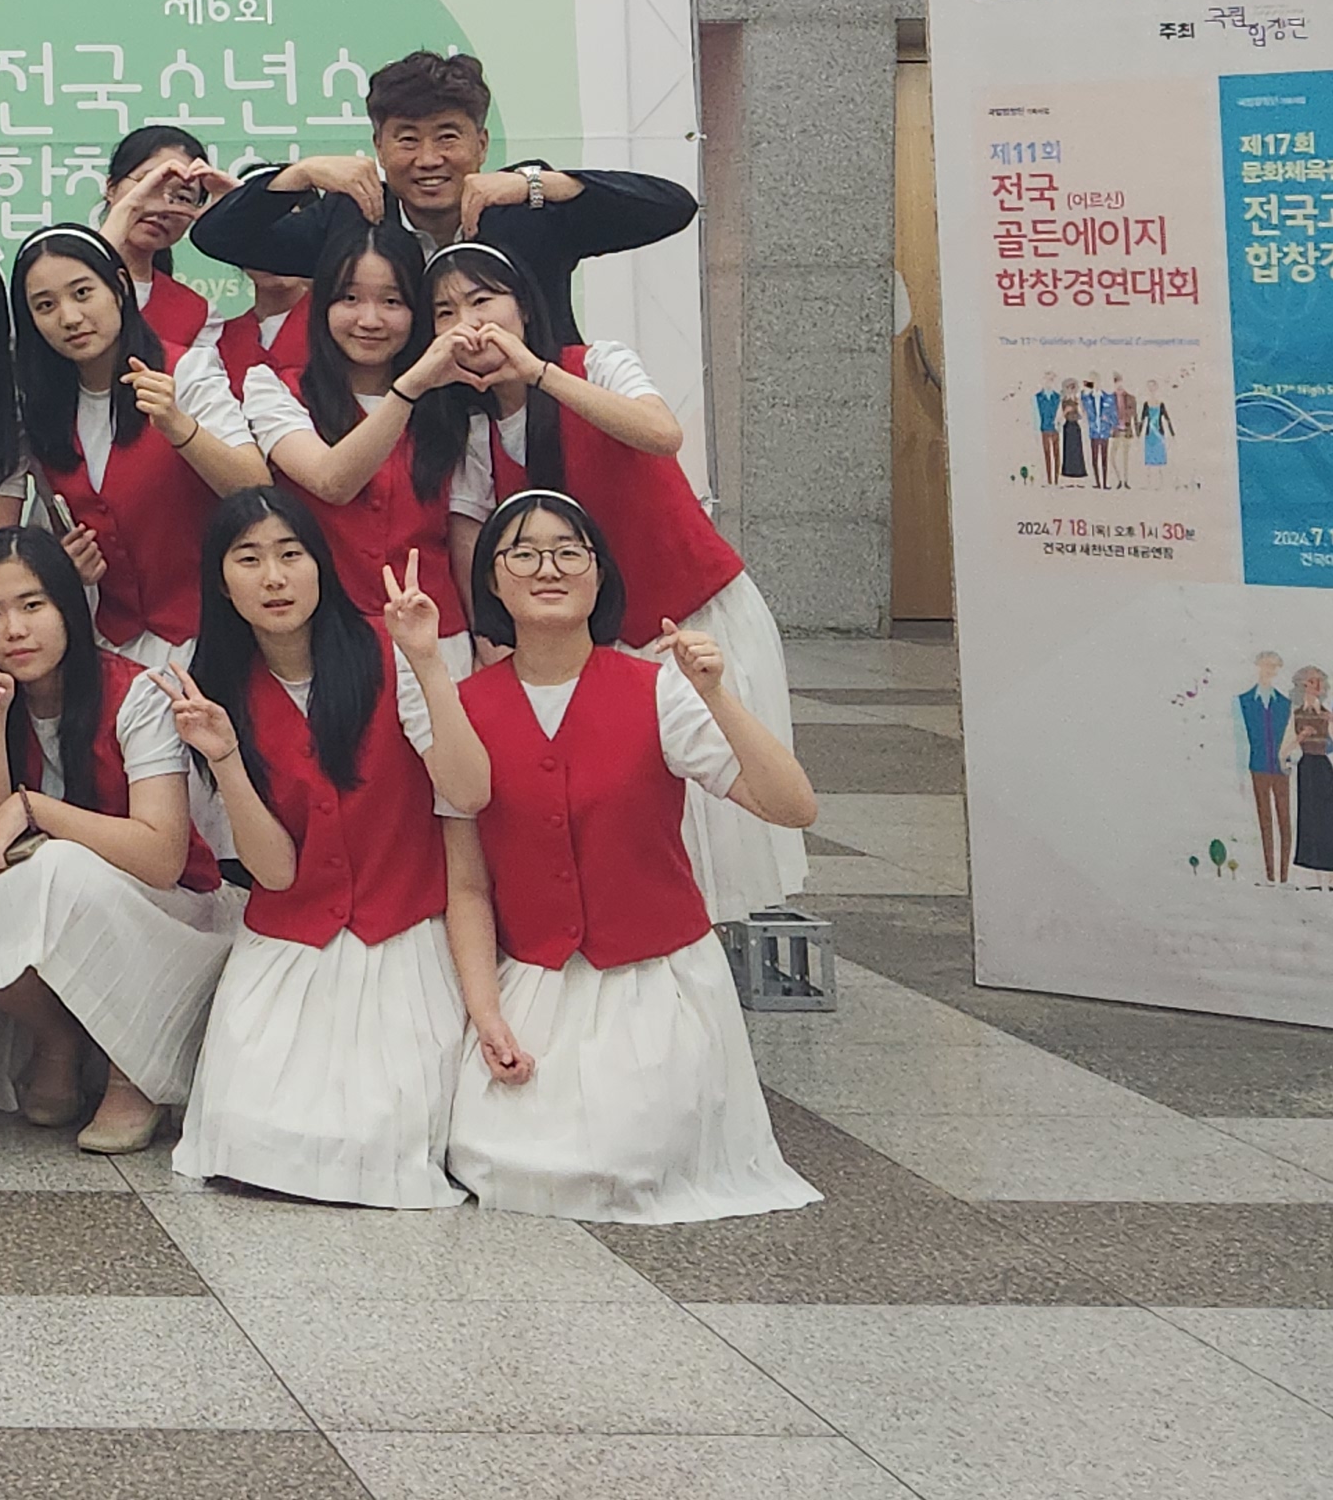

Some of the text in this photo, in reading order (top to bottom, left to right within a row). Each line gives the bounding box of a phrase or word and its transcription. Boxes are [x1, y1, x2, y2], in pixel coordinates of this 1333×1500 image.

[1159, 22, 1195, 40] 주최
[990, 140, 1062, 166] 제11회
[1239, 131, 1316, 156] 제17회
[991, 172, 1125, 212] 전국 (어르신)
[993, 215, 1167, 259] 골든에이지
[178, 274, 240, 301] oys
[995, 267, 1200, 307] 합창경연대회
